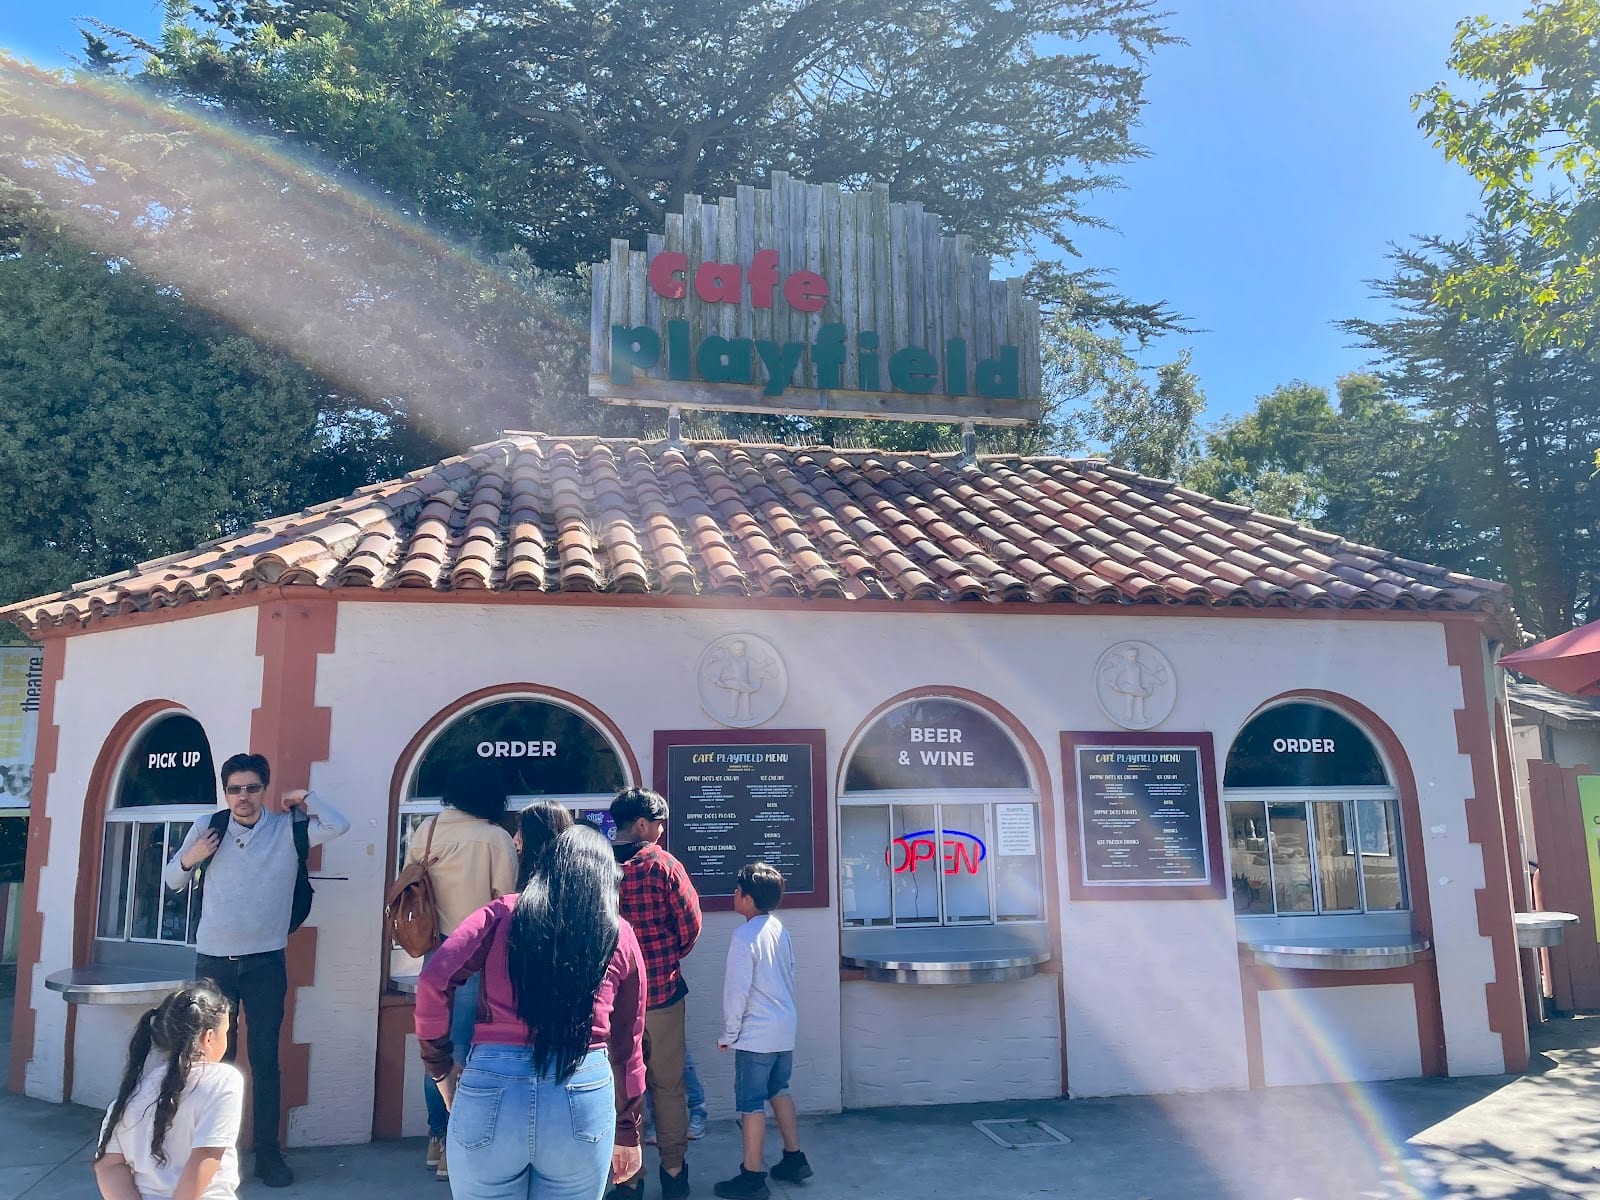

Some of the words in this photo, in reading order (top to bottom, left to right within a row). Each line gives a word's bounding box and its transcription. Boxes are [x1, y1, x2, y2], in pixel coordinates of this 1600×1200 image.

[610, 319, 1020, 399] playfield
[20, 657, 43, 713] theatre
[910, 727, 962, 744] BEER
[477, 740, 557, 758] ORDER
[1272, 738, 1335, 753] ORDER
[148, 752, 177, 769] PICK
[182, 751, 201, 768] UP
[716, 753, 764, 765] PLAYFIELD
[765, 753, 789, 763] MENU
[898, 750, 911, 766] &
[919, 750, 975, 767] WINE
[1159, 753, 1181, 763] MENU
[885, 837, 980, 876] OPEN
